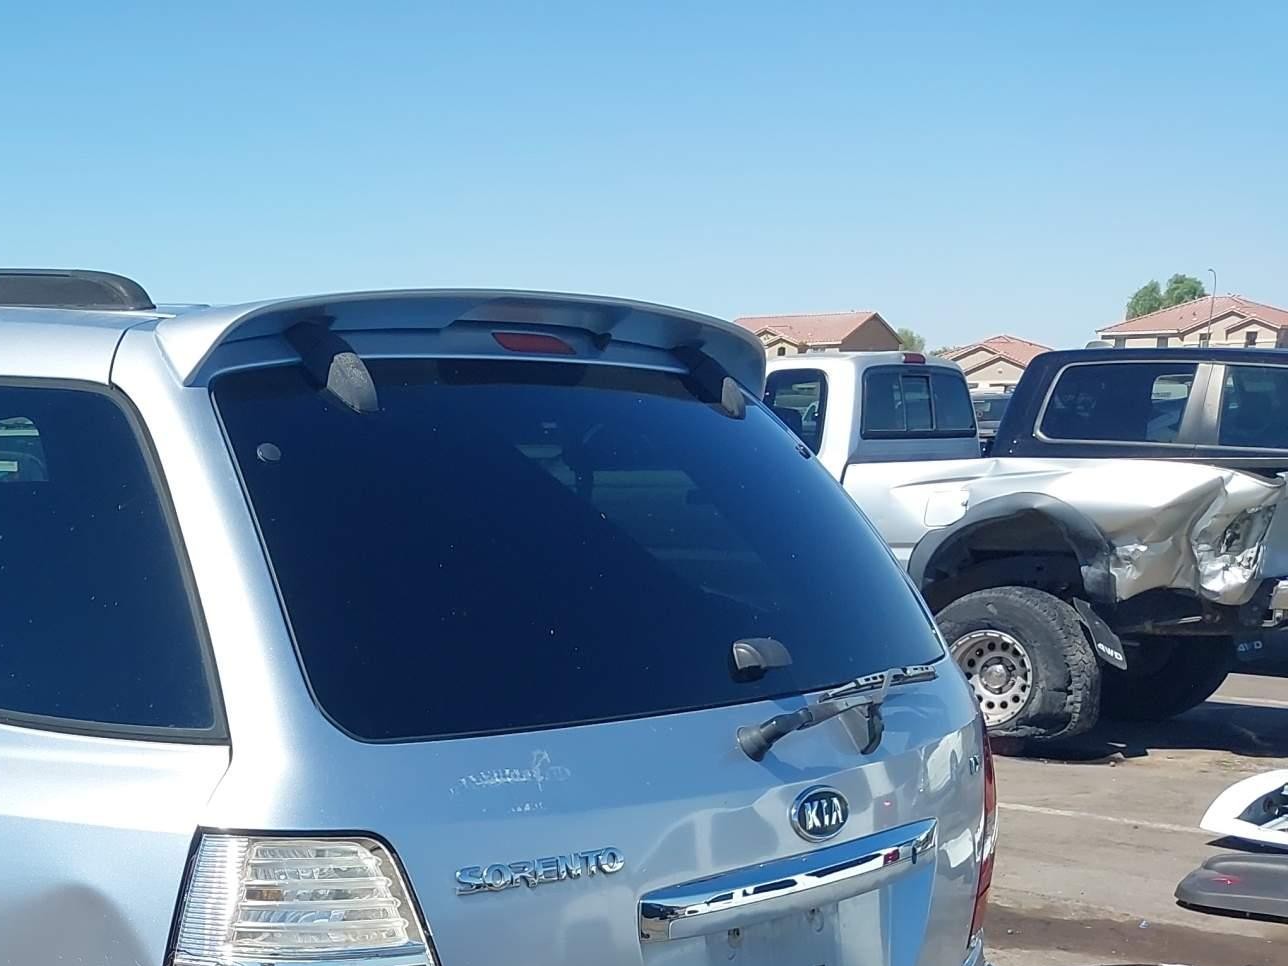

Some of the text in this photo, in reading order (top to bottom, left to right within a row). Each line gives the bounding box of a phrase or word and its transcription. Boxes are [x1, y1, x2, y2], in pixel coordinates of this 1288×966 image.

[1097, 642, 1123, 661] 4WD
[1238, 640, 1263, 652] 4D
[804, 797, 844, 831] KIA
[455, 846, 625, 896] SORENTO
